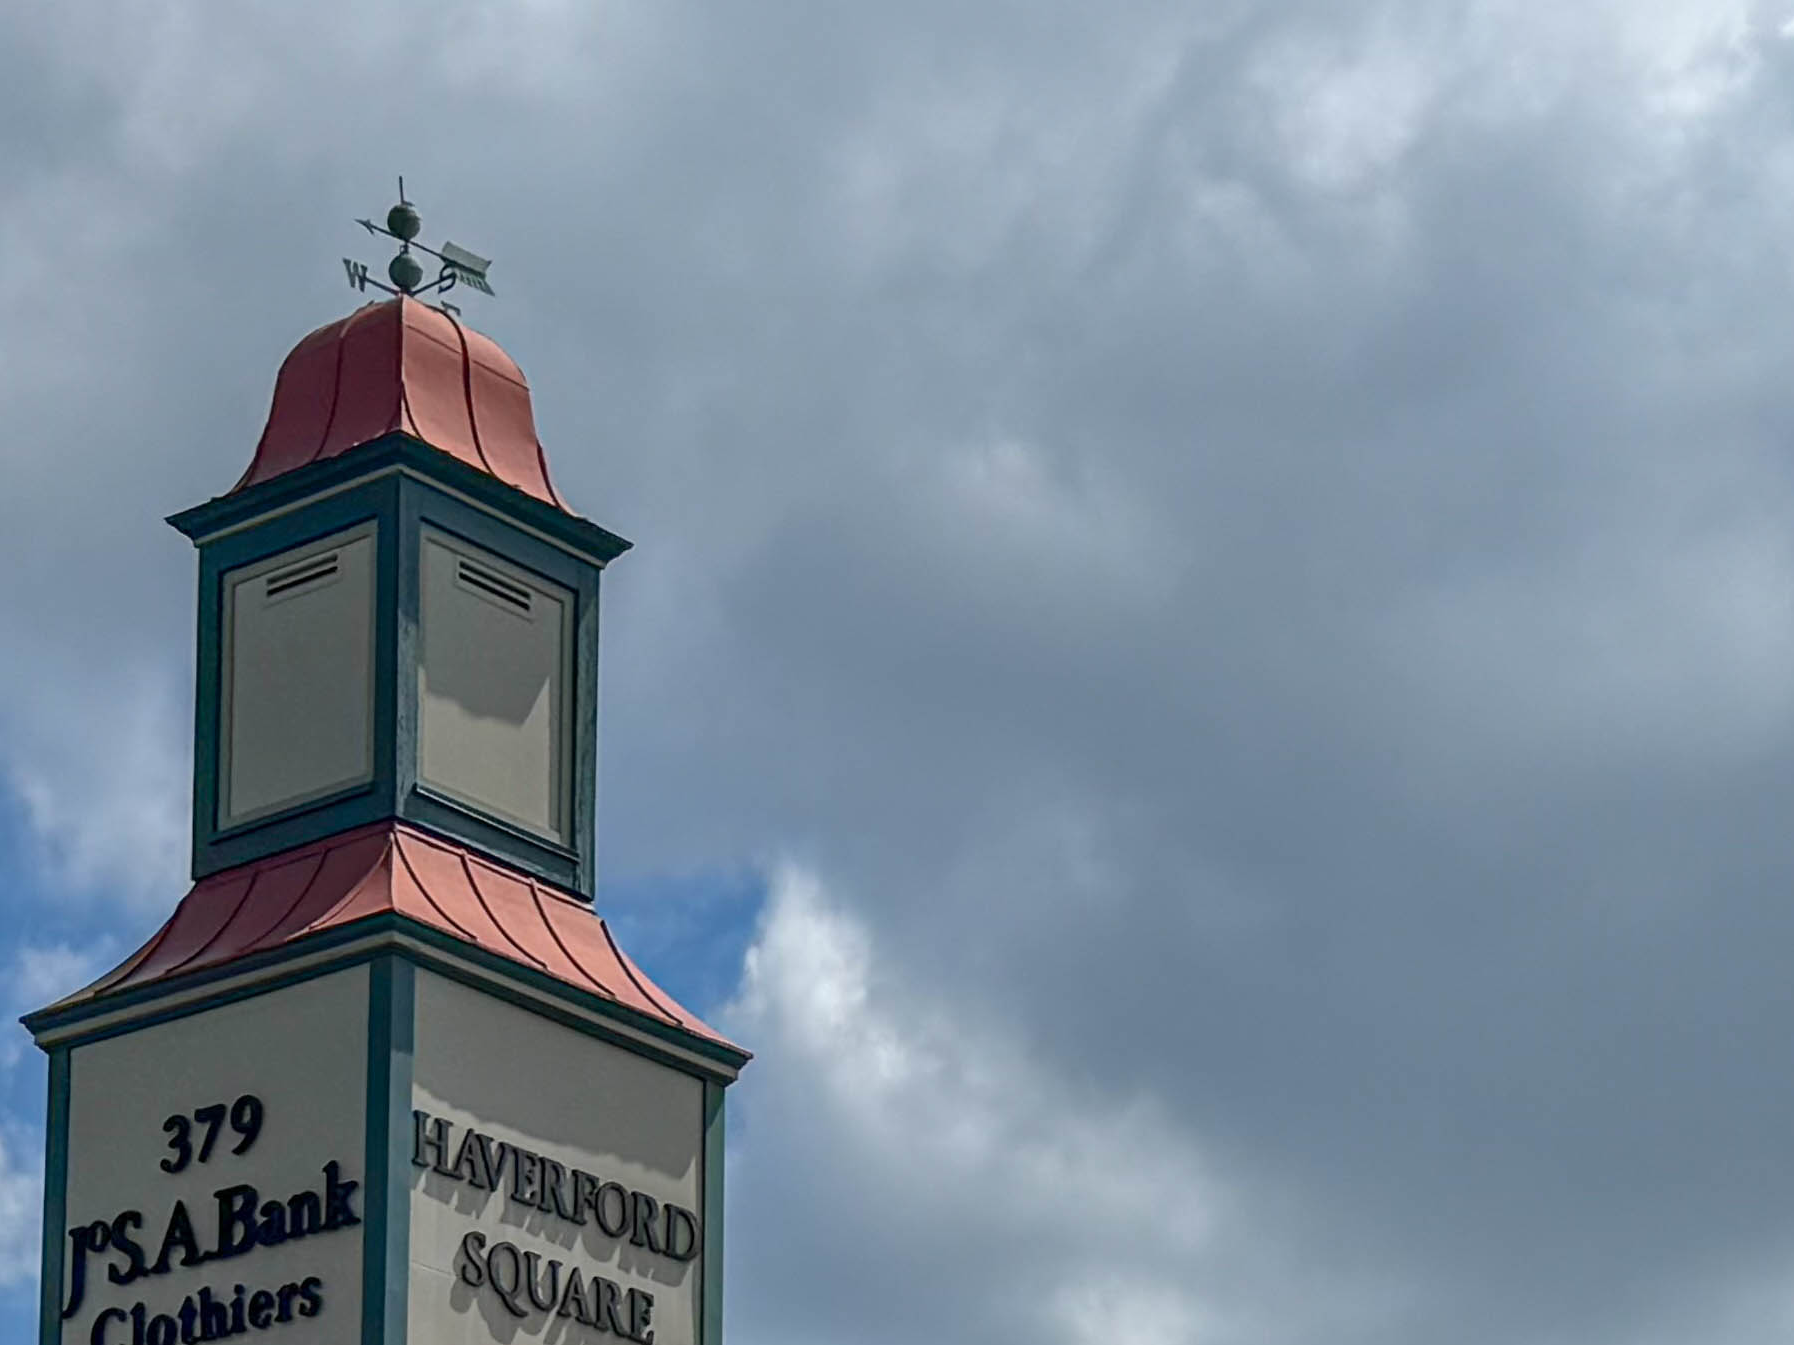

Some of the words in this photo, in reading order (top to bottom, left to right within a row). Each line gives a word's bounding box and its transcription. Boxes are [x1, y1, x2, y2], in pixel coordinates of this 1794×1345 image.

[160, 1094, 263, 1174] 379
[412, 1109, 701, 1262] HAVERFORD
[461, 1231, 654, 1345] SQUARE
